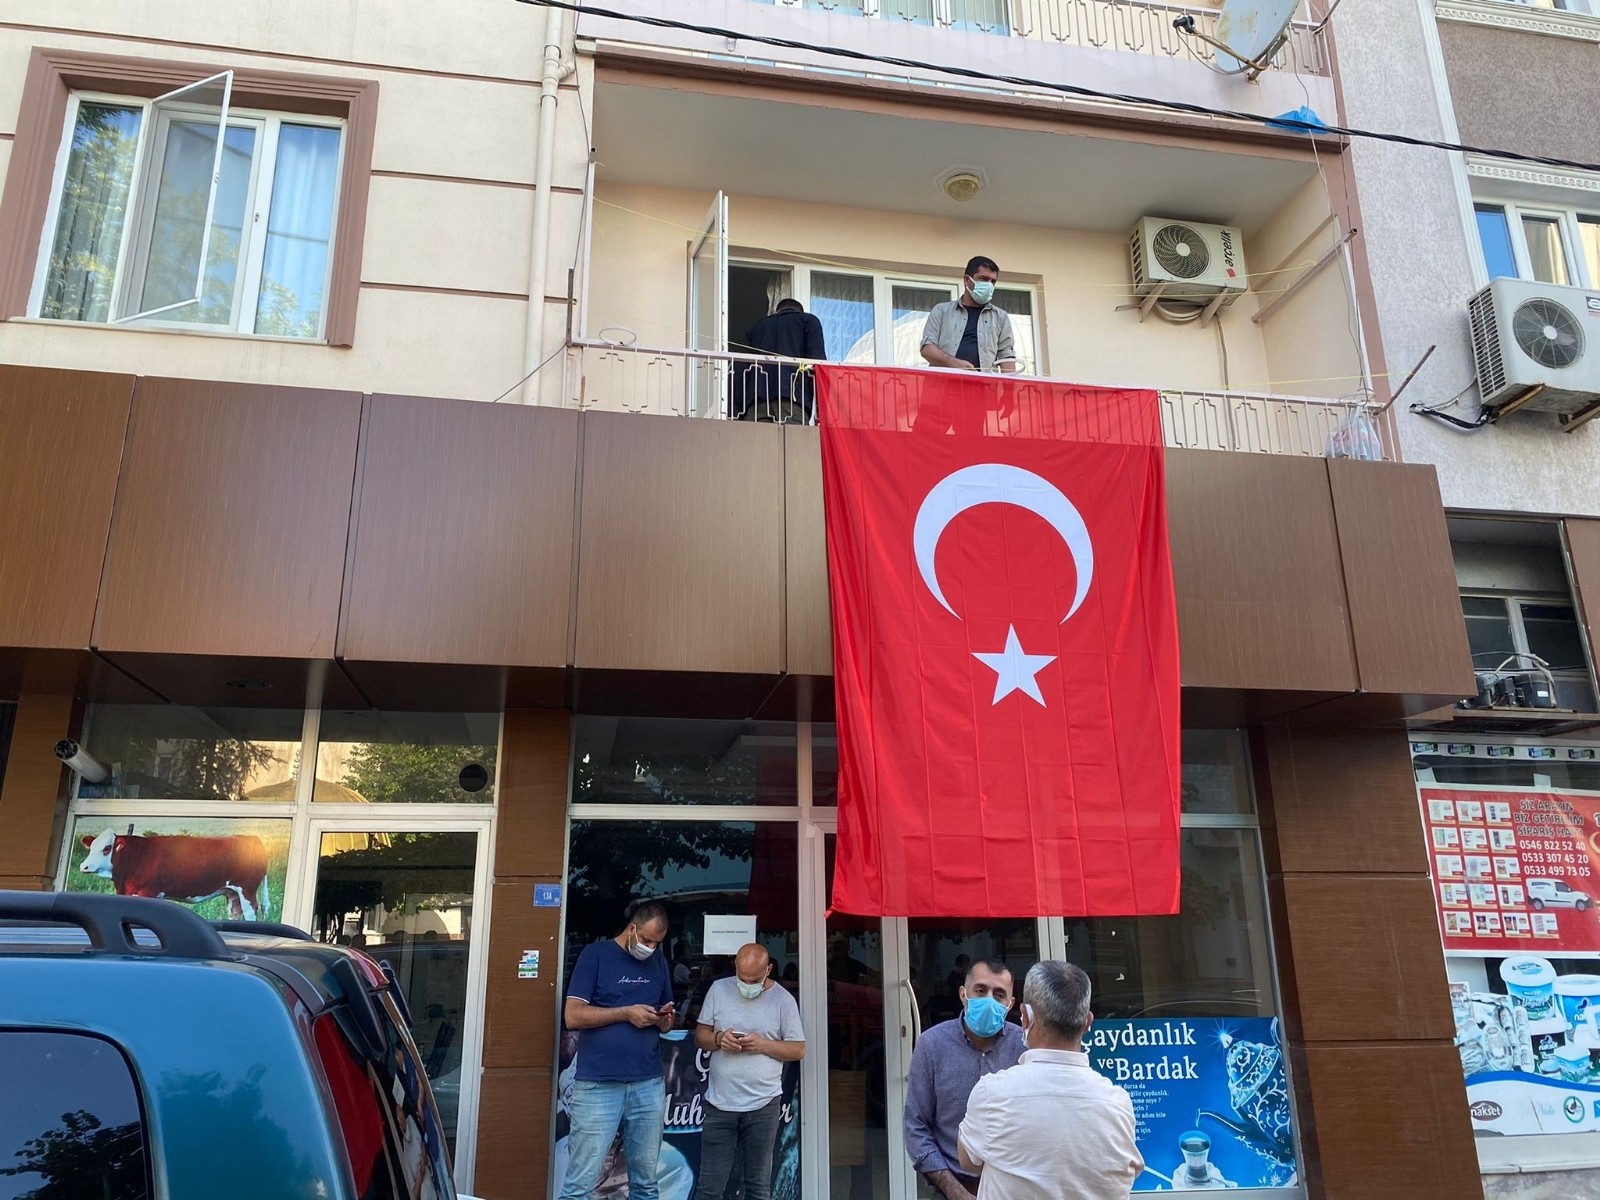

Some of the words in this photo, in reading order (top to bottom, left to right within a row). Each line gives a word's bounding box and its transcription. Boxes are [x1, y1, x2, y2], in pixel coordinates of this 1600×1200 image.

[1220, 229, 1235, 267] arçelik
[1514, 811, 1530, 823] BİZ
[1517, 824, 1555, 839] SİPARİŞ
[1520, 840, 1542, 850] 0546
[1544, 840, 1560, 850] 822
[1562, 841, 1573, 851] 52
[1575, 841, 1586, 851] 40
[1522, 852, 1544, 862] 0533
[1546, 853, 1562, 863] 307
[1564, 854, 1575, 863] 45
[1577, 854, 1589, 864] 20
[1524, 865, 1546, 875] 0533
[1548, 866, 1565, 876] 499
[1566, 866, 1578, 876] 73
[1579, 867, 1591, 876] 05
[1081, 1021, 1197, 1054] Çaydanlık
[1097, 1057, 1114, 1069] ve
[1114, 1055, 1199, 1080] Bardak
[1470, 1107, 1501, 1117] nakset
